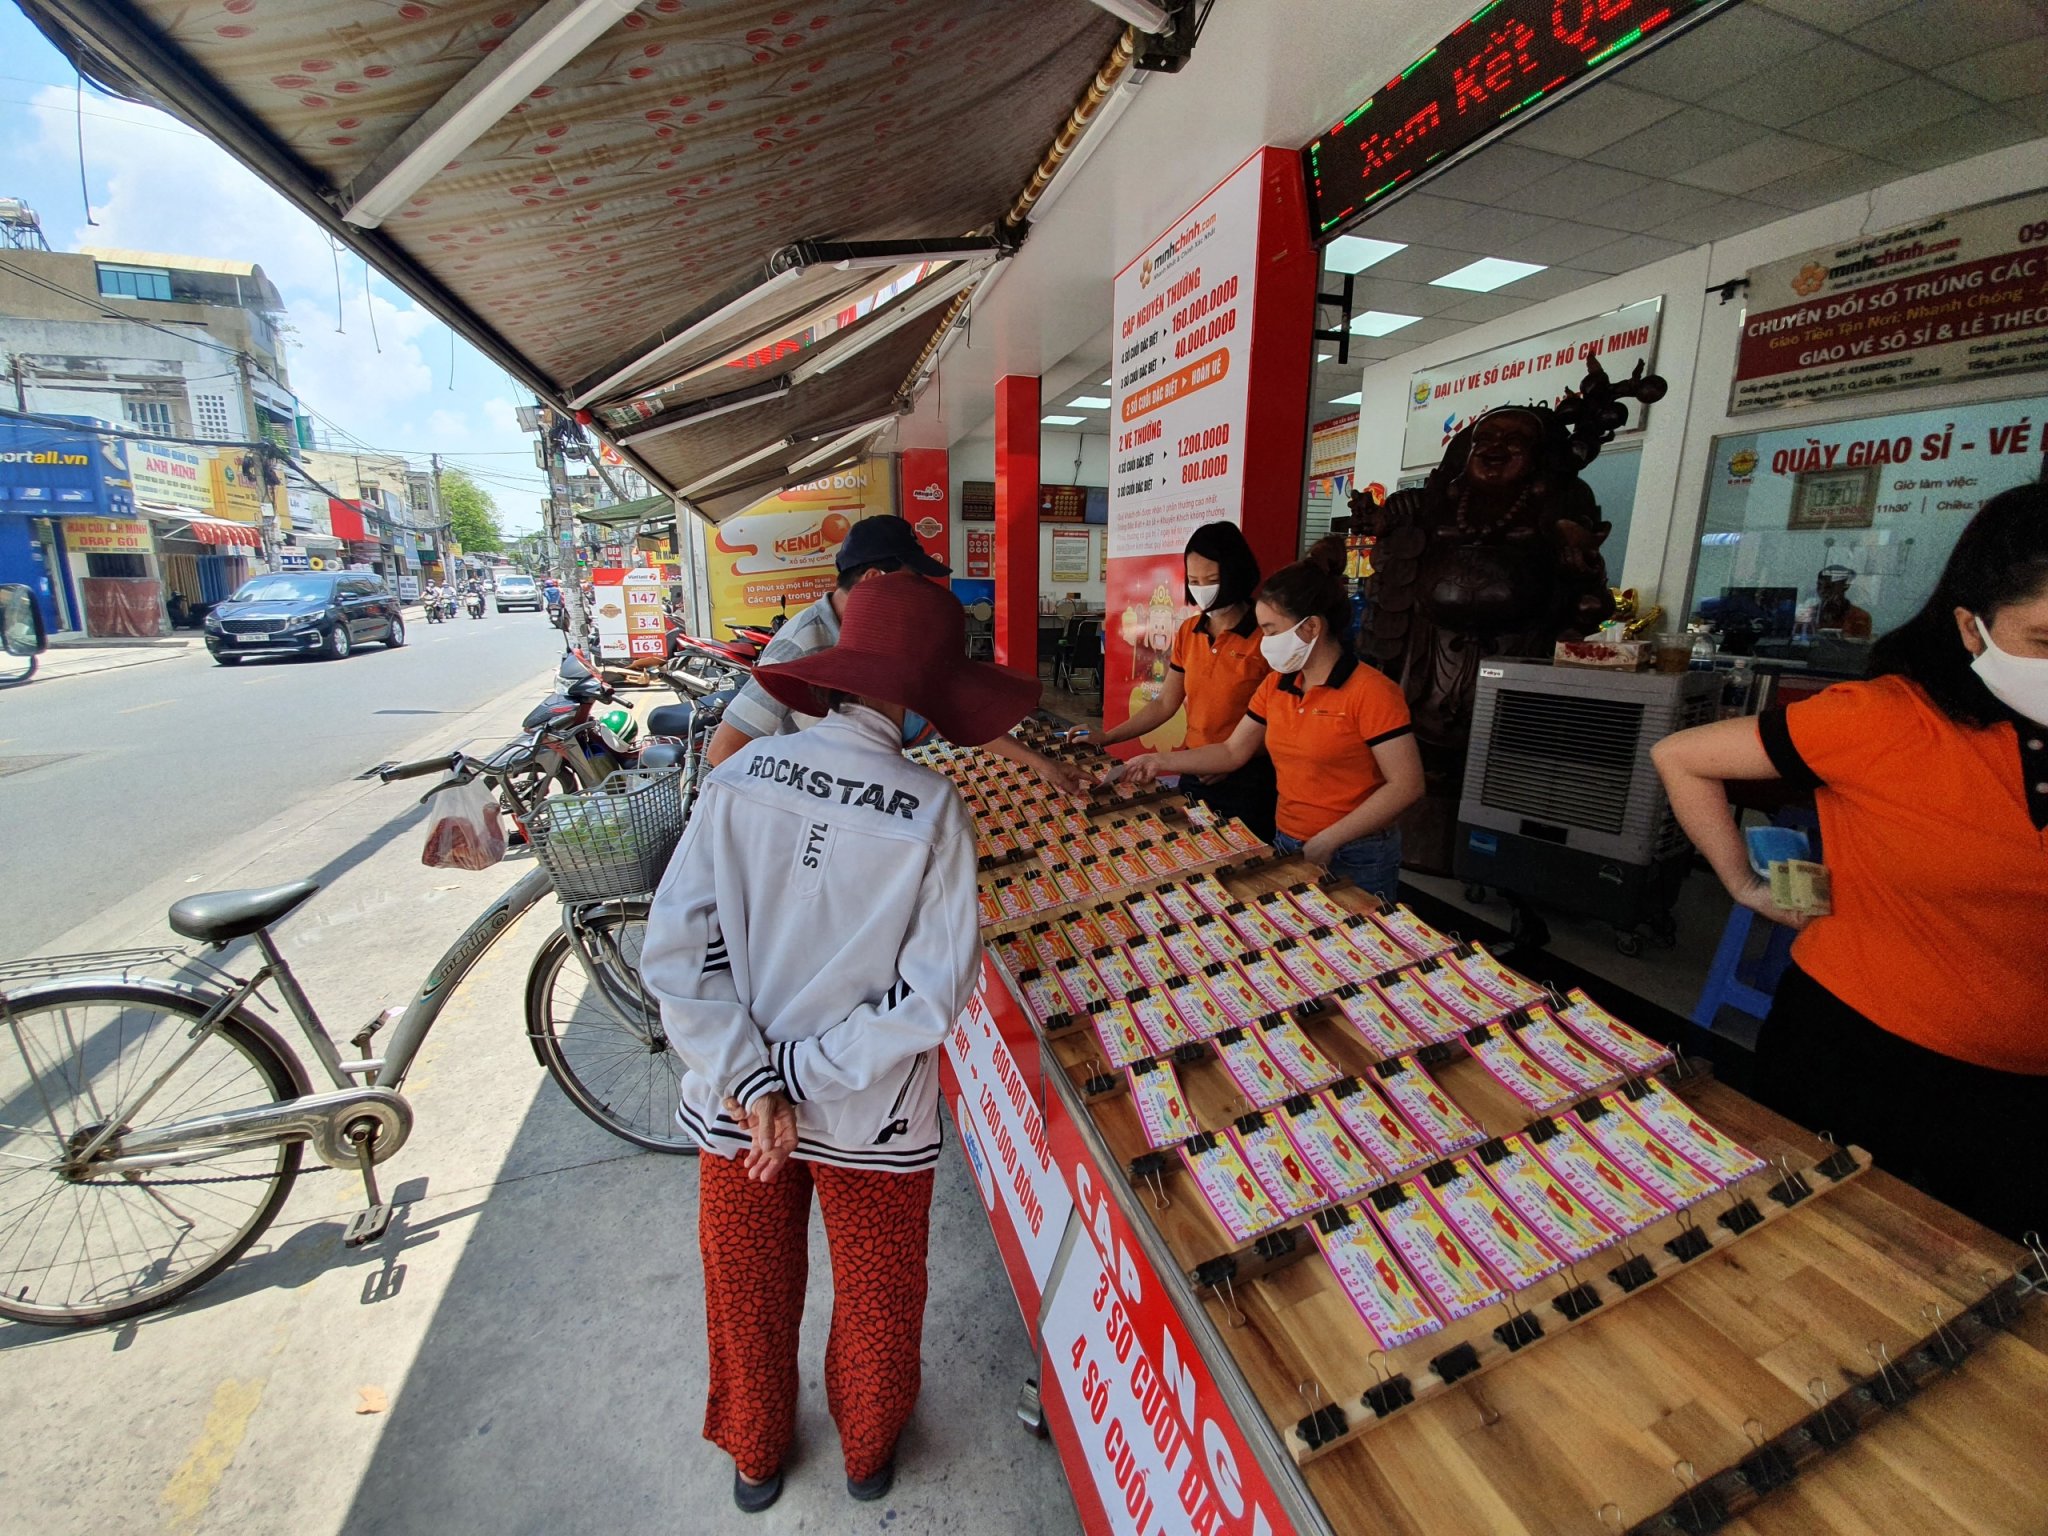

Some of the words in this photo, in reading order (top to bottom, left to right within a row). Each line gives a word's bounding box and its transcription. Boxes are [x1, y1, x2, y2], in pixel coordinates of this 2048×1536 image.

[1903, 268, 1982, 303] TRÚNG
[1990, 254, 2036, 284] CÁC
[1172, 275, 1238, 334] 160.000.000Đ
[1906, 298, 1961, 321] Nhanh
[1175, 308, 1236, 360] 40.000.000Đ
[1799, 345, 1844, 366] GIAO
[1850, 336, 1874, 356] VÉ
[1936, 323, 1953, 340] &
[1435, 381, 1450, 400] ĐẠI
[1454, 376, 1466, 393] LÝ
[1484, 363, 1500, 386] SỐ
[1607, 326, 1649, 353] MINH
[1126, 403, 1129, 417] 2
[1118, 435, 1123, 452] 2
[1177, 423, 1230, 458] 1.200.000Đ
[1772, 438, 1840, 476] QUẦY
[1847, 437, 1912, 467] GIAO
[1921, 423, 1955, 461] SỈ
[1990, 416, 2032, 455] VÉ
[146, 457, 168, 473] ANH
[171, 462, 196, 480] MINH
[834, 472, 867, 489] ĐÓN
[1181, 454, 1228, 485] 800.000Đ
[1894, 481, 1916, 490] Giờ
[1920, 479, 1942, 488] làm
[1947, 476, 1978, 489] việc:
[80, 537, 112, 546] DRAP
[108, 524, 122, 533] AH
[126, 524, 147, 534] MINH
[775, 531, 821, 553] KENO
[817, 554, 832, 563] CHỌN
[748, 596, 763, 604] Các
[757, 584, 775, 592] Phút
[746, 755, 920, 820] ROCKSTAR
[803, 823, 829, 869] STYL
[993, 1040, 1026, 1117] 800.000
[955, 1024, 971, 1064] BIỆT
[980, 1083, 1017, 1175] 1.200.000
[1014, 1161, 1044, 1239] ĐỒNG
[1351, 1122, 1395, 1166] 816322
[1206, 1183, 1242, 1232] 819118
[1564, 1170, 1627, 1226] 001106
[1076, 1163, 1142, 1305] CẶP
[1514, 1193, 1573, 1251] 621805
[1094, 1271, 1110, 1312] 3
[1400, 1239, 1455, 1305] 921803
[1339, 1265, 1388, 1333] 821802
[1072, 1334, 1087, 1371] 4
[1082, 1359, 1113, 1425] SỐ
[1104, 1417, 1154, 1536] CUỐI
